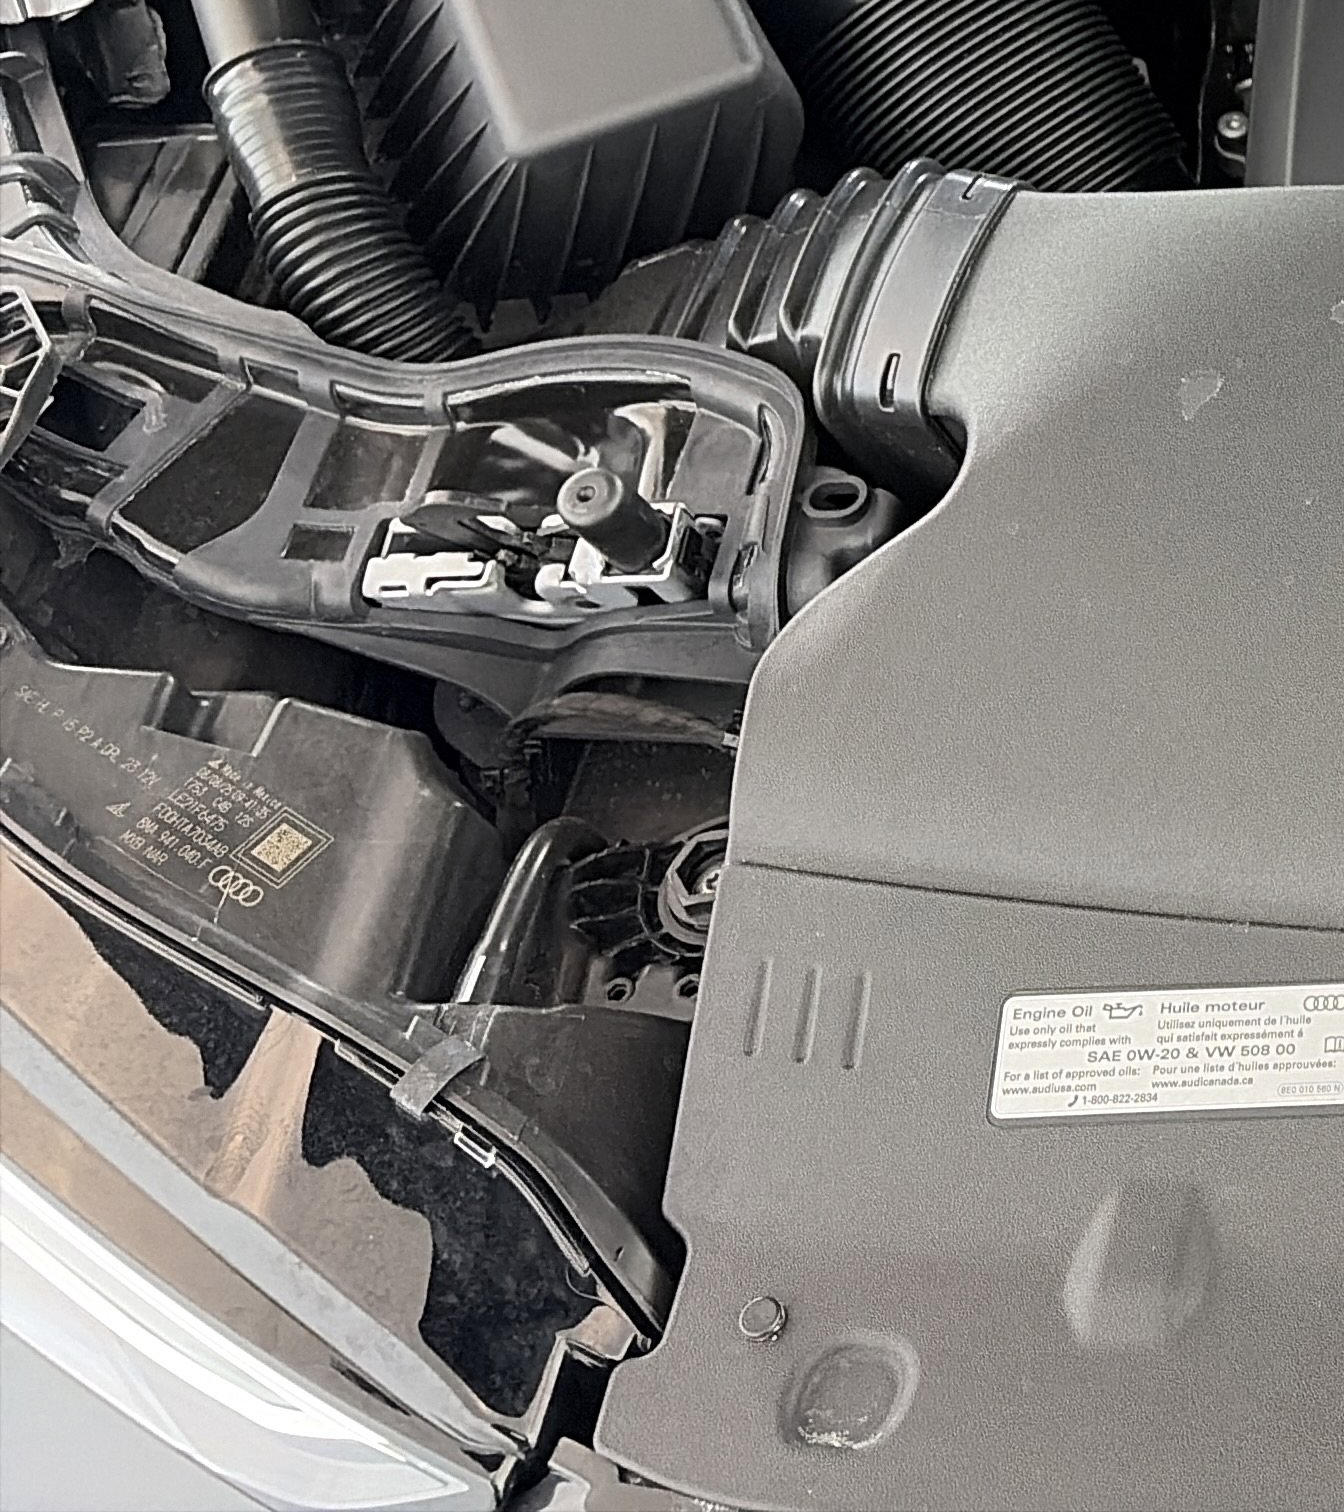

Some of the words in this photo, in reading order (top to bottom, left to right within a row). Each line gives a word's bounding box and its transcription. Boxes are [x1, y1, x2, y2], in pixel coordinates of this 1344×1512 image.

[1013, 1007, 1066, 1021] Engine
[1072, 1005, 1093, 1017] Oil
[1160, 1001, 1200, 1014] Huile
[1205, 1001, 1265, 1013] moteur
[1009, 1026, 1030, 1036] Use
[1033, 1025, 1056, 1036] only
[1059, 1024, 1072, 1033] oil
[1075, 1023, 1096, 1033] that
[1158, 1019, 1196, 1030] Utilisez
[1199, 1018, 1261, 1030] uniquement
[1264, 1017, 1277, 1026] de
[1279, 1015, 1312, 1026] l'huile
[1008, 1038, 1057, 1051] expressly
[1059, 1036, 1106, 1048] complies
[1109, 1035, 1131, 1045] with
[1157, 1033, 1174, 1044] qui
[1176, 1031, 1218, 1043] satisfait
[1220, 1030, 1295, 1042] expressément
[1087, 1050, 1122, 1063] SAE
[1127, 1048, 1181, 1061] 0W-20
[1186, 1047, 1199, 1059] &
[1205, 1046, 1236, 1058] VW
[1241, 1044, 1271, 1056] 508
[1276, 1043, 1296, 1055] 00
[1003, 1072, 1020, 1081] For
[1024, 1073, 1030, 1081] a
[1033, 1070, 1049, 1080] list
[1052, 1069, 1063, 1079] of
[1065, 1068, 1115, 1080] approved
[1118, 1067, 1140, 1076] oils:
[1152, 1065, 1178, 1076] Pour
[1181, 1065, 1200, 1074] une
[1203, 1062, 1225, 1073] liste
[1272, 1059, 1337, 1071] approuvées:
[1002, 1083, 1097, 1095] www.audiusa.com
[1151, 1076, 1254, 1088] www.audicanada.ca
[1082, 1092, 1158, 1105] 1-800-822-2834
